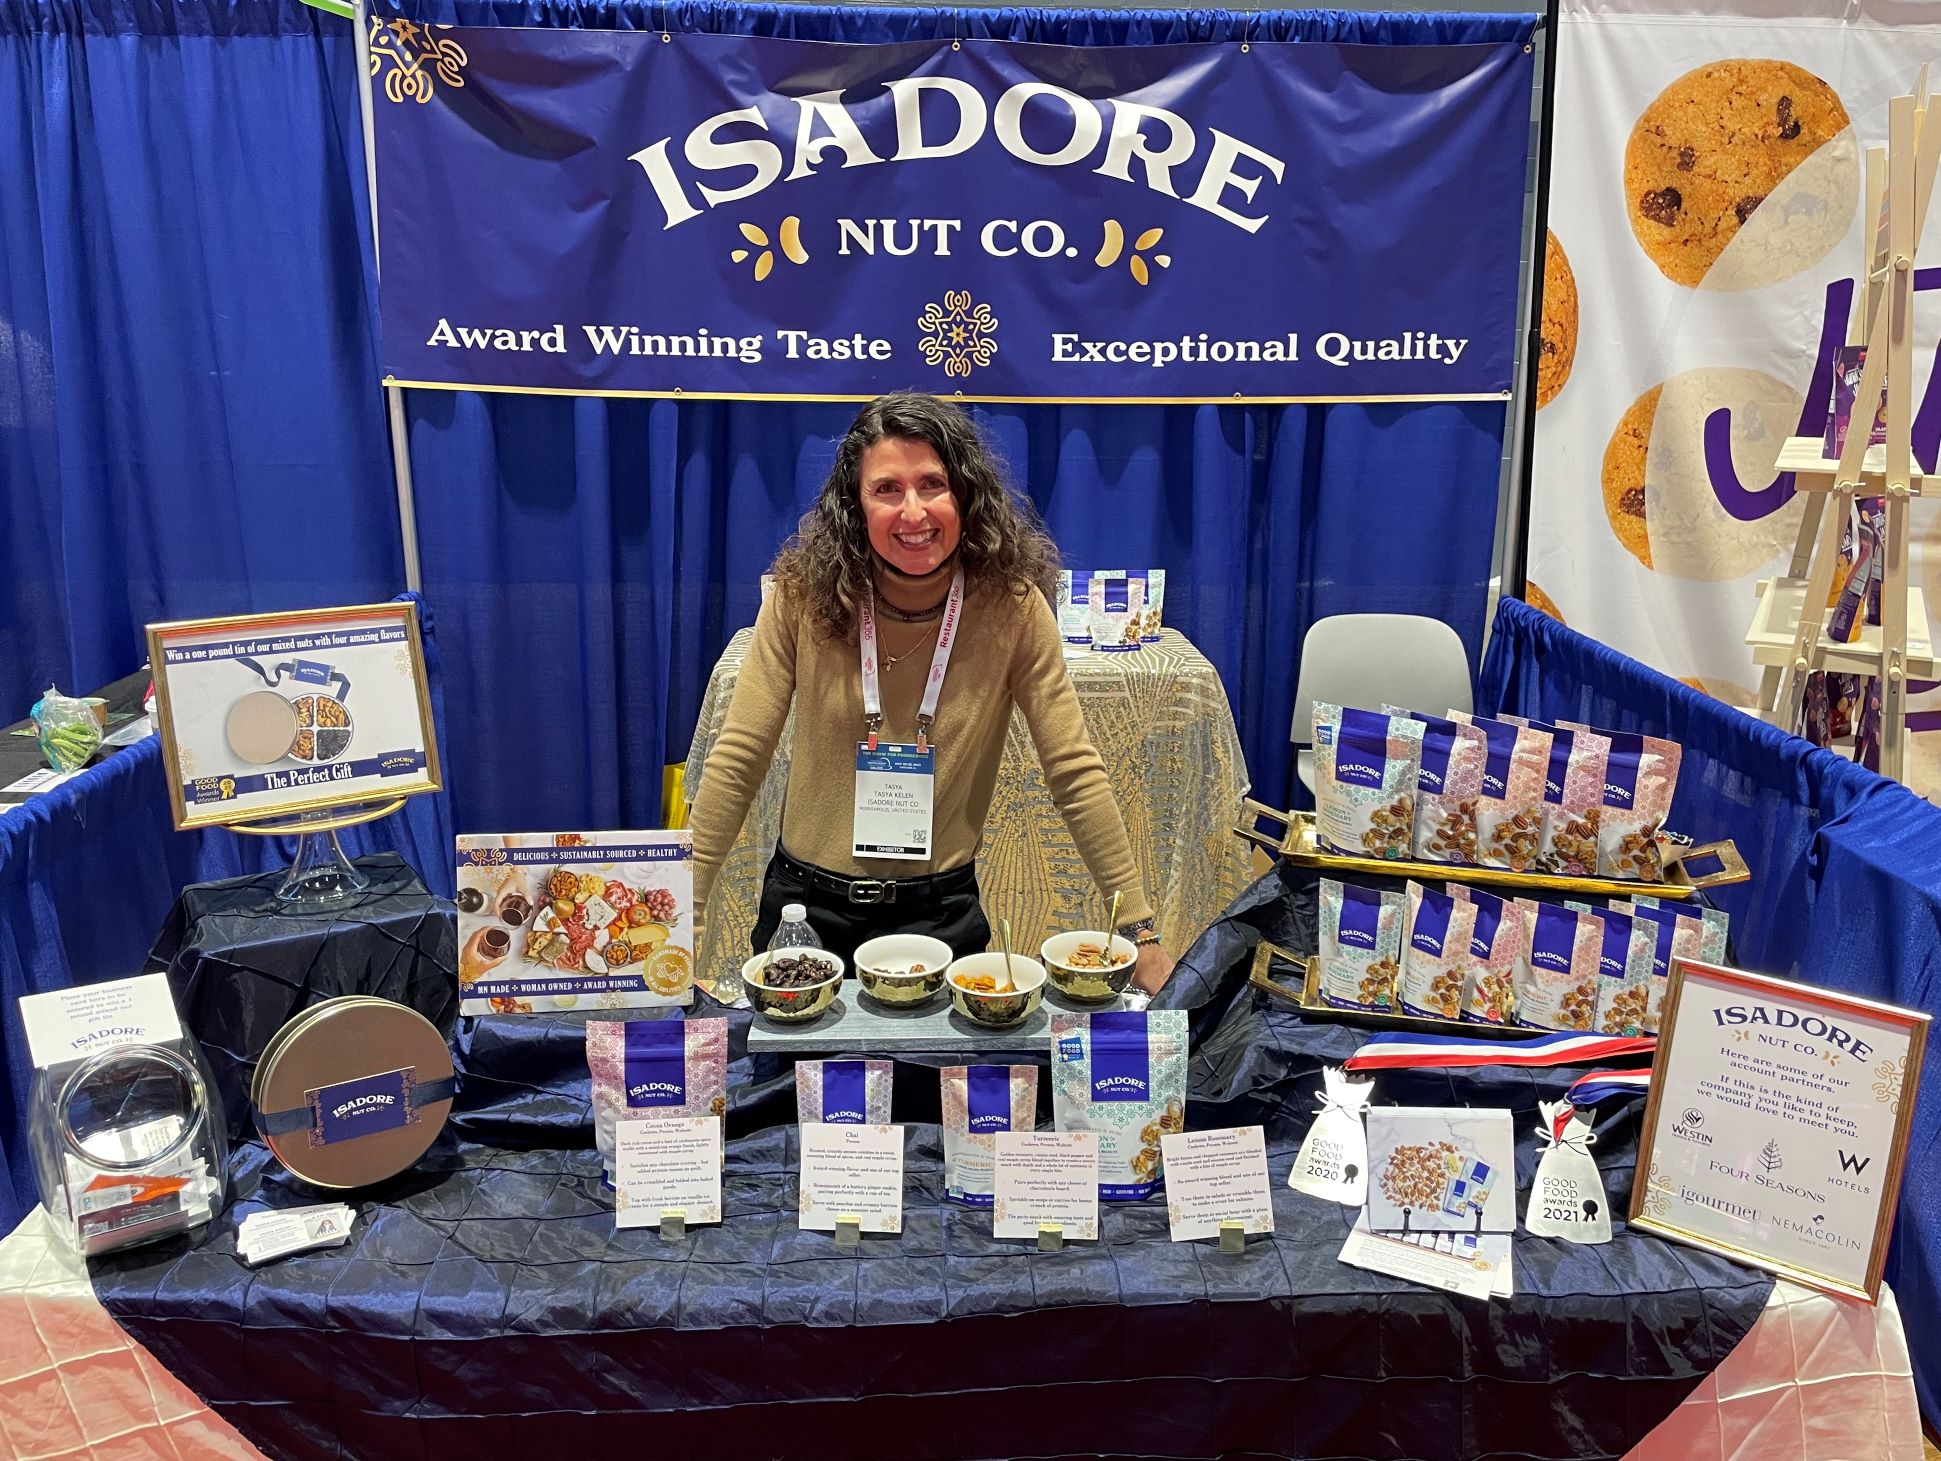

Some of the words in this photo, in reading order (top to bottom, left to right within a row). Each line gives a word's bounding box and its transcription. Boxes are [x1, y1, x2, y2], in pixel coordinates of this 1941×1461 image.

[627, 77, 1285, 234] ISADORE
[839, 219, 960, 256] NUT
[982, 219, 1078, 258] CO.
[427, 319, 566, 354] Award
[583, 323, 765, 364] Winning
[776, 328, 892, 362] Taste
[1051, 330, 1299, 370] Exceptional
[1316, 330, 1468, 367] Quality
[940, 585, 959, 648] Restaurant365
[166, 650, 182, 660] Win
[209, 644, 233, 658] pound
[235, 644, 246, 654] tin
[248, 642, 255, 653] of
[257, 643, 270, 651] our
[272, 639, 295, 650] mixed
[297, 639, 313, 648] nuts
[315, 636, 331, 646] with
[333, 634, 347, 644] four
[350, 631, 379, 642] amazing
[380, 630, 404, 640] flavors
[265, 773, 287, 789] The
[290, 765, 330, 785] Perfect
[332, 763, 352, 779] Gift
[1339, 764, 1381, 779] ISADORE
[1419, 769, 1442, 785] DORE
[196, 783, 218, 791] FOOD
[1484, 774, 1504, 790] DORE
[1604, 784, 1631, 800] DORE
[513, 852, 549, 860] DELICIOUS
[560, 851, 603, 859] SUSTAINABLY
[606, 849, 636, 858] SOURCED
[647, 849, 677, 857] HEALTHY
[1341, 930, 1374, 943] ISADORE
[1414, 934, 1442, 950] ISADORE
[1534, 952, 1570, 966] ISADORE
[1601, 956, 1623, 970] DORE
[478, 985, 488, 994] MN
[490, 984, 509, 993] MADE
[521, 983, 547, 992] WOMAN
[548, 982, 572, 990] OWNED
[583, 981, 606, 989] AWARD
[609, 980, 638, 988] WINNING
[71, 1027, 146, 1048] ISADORE
[1712, 1007, 1873, 1063] ISADORE
[1758, 1034, 1789, 1048] NUT
[1794, 1043, 1818, 1057] CO.
[1720, 1047, 1749, 1061] Here
[1753, 1057, 1772, 1067] are
[1776, 1063, 1812, 1076] some
[1812, 1072, 1825, 1081] of
[1829, 1078, 1850, 1087] our
[1095, 1077, 1146, 1090] ISADORE
[1730, 1061, 1776, 1077] account
[1781, 1073, 1835, 1094] partners.
[630, 1083, 682, 1096] ISADORE
[1720, 1075, 1730, 1083] If
[1734, 1079, 1755, 1091] this
[1760, 1085, 1768, 1094] is
[1773, 1089, 1792, 1100] the
[1796, 1095, 1822, 1109] kind
[1827, 1104, 1840, 1114] of
[332, 1095, 395, 1118] ISADORE
[1697, 1088, 1712, 1098] we
[1716, 1094, 1750, 1108] would
[1755, 1103, 1779, 1116] love
[1783, 1111, 1794, 1120] to
[1799, 1117, 1829, 1129] meet
[1833, 1125, 1858, 1138] you.
[1700, 1080, 1754, 1100] company
[1758, 1096, 1779, 1107] you
[1784, 1102, 1805, 1114] like
[1809, 1110, 1821, 1118] to
[1826, 1114, 1858, 1129] keep,
[826, 1110, 863, 1121] ISADORE
[971, 1116, 1008, 1125] ISADORE
[1672, 1124, 1712, 1144] WESTIN
[1838, 1150, 1870, 1176] W
[1307, 1166, 1338, 1180] 2020
[1709, 1160, 1750, 1181] FOUR
[1755, 1174, 1825, 1204] SEASONS
[1543, 1177, 1577, 1188] GOOD
[1828, 1177, 1870, 1194] HOTELS
[1544, 1187, 1577, 1198] FOOD
[1543, 1198, 1577, 1207] awards
[1680, 1185, 1759, 1221] igourmet
[1544, 1207, 1578, 1222] 2021
[1772, 1216, 1861, 1250] NEMACOLIN
